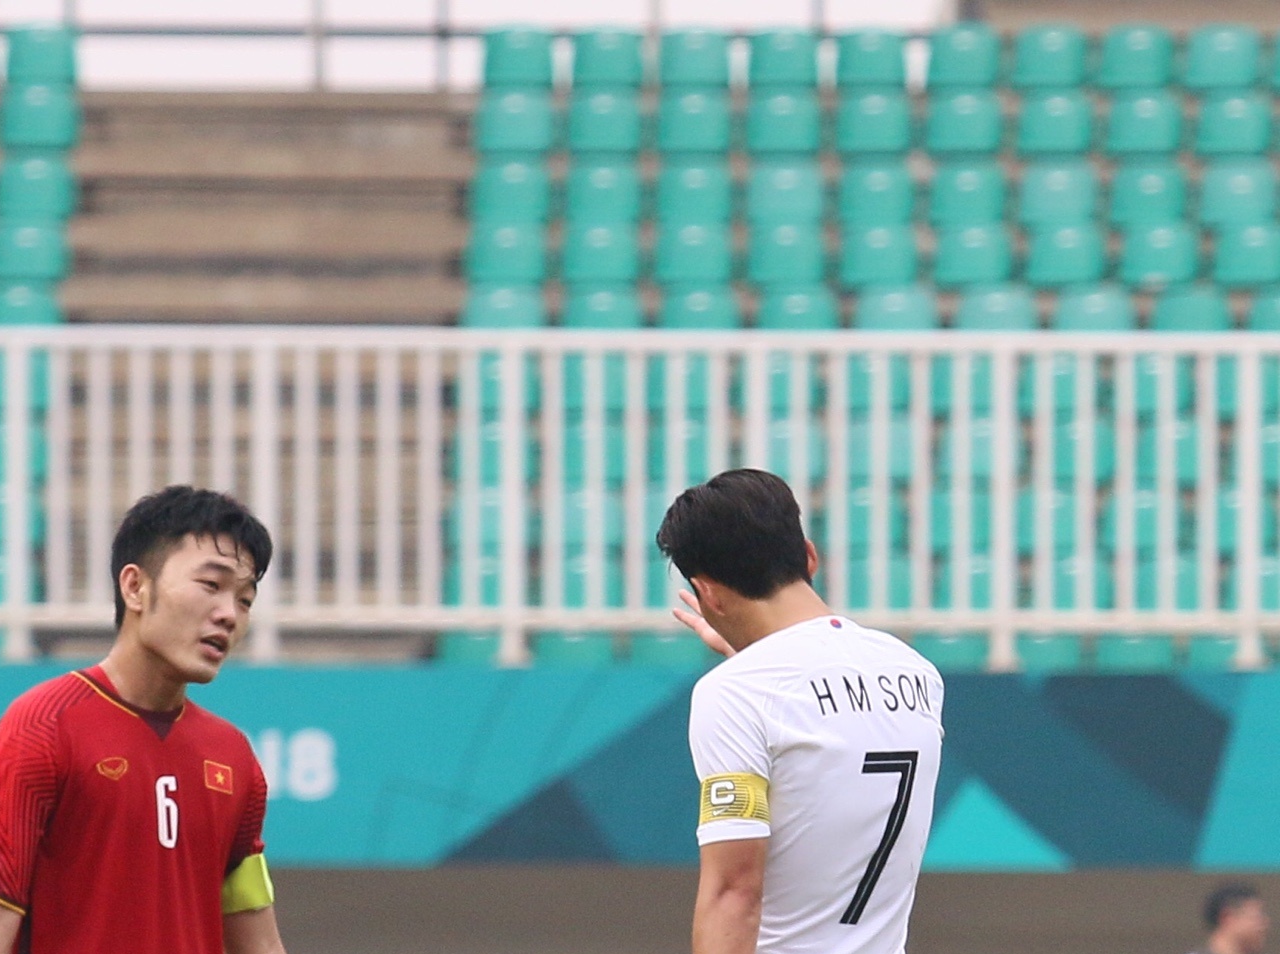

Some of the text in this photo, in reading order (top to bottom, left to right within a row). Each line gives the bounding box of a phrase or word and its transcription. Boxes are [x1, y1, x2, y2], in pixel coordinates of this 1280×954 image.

[810, 674, 932, 716] H M SON
[154, 774, 180, 850] 6
[710, 780, 736, 807] C
[838, 750, 919, 926] 7
